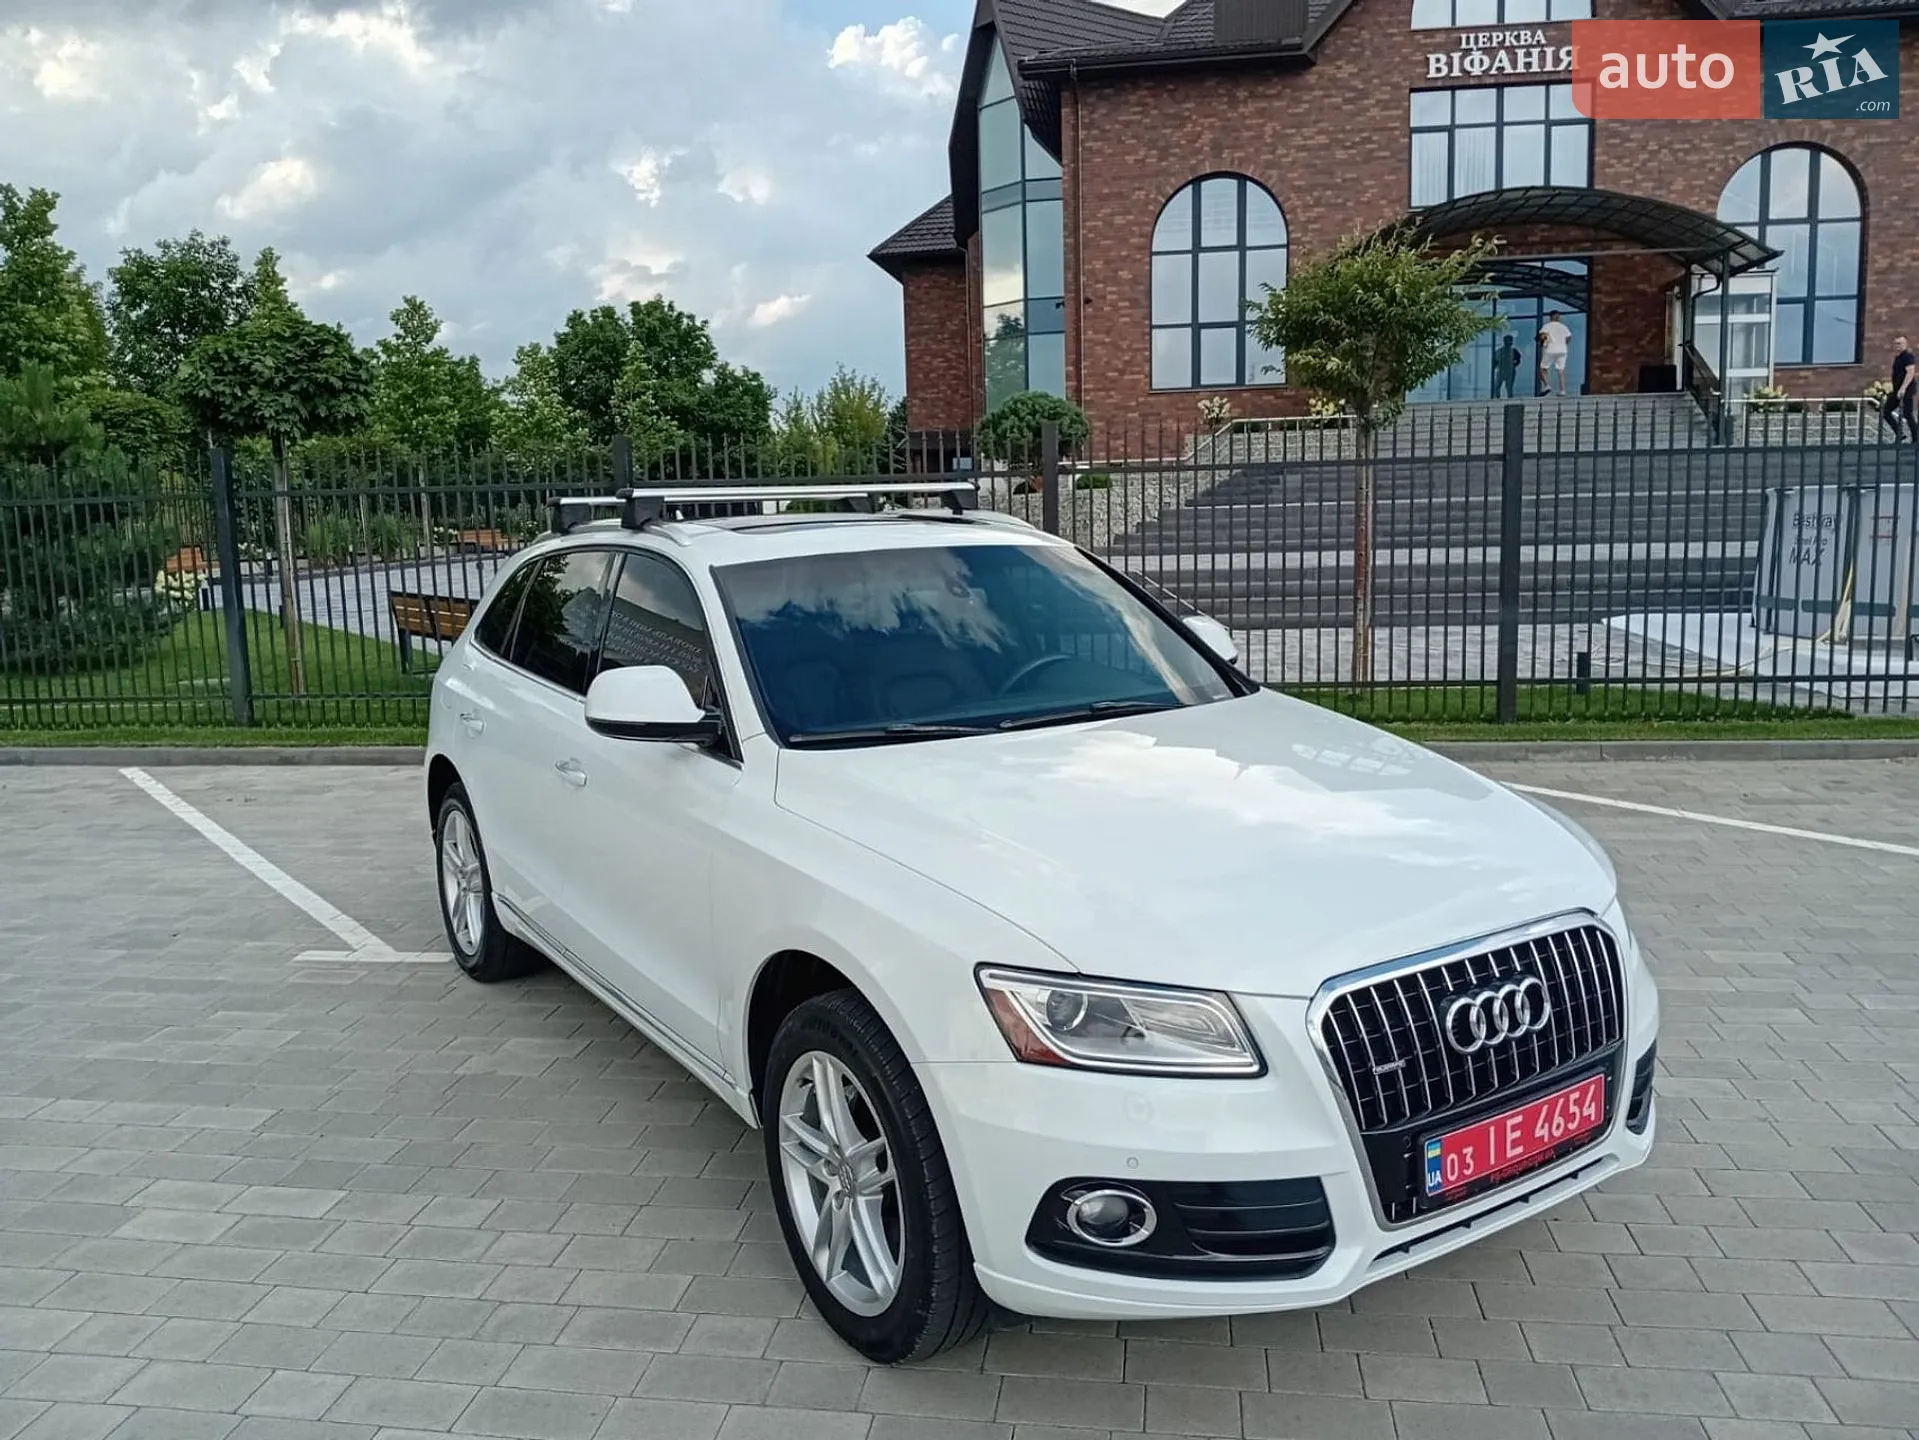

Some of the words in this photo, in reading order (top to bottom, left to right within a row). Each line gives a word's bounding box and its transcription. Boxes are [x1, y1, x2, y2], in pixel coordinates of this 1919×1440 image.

[1460, 29, 1547, 51] ЦЕРКВА
[1426, 45, 1580, 78] ВІФАНІЯ
[1446, 1145, 1474, 1182] 03
[1489, 1115, 1524, 1166] IE
[1534, 1084, 1595, 1142] 4654
[1428, 1170, 1442, 1187] UA
